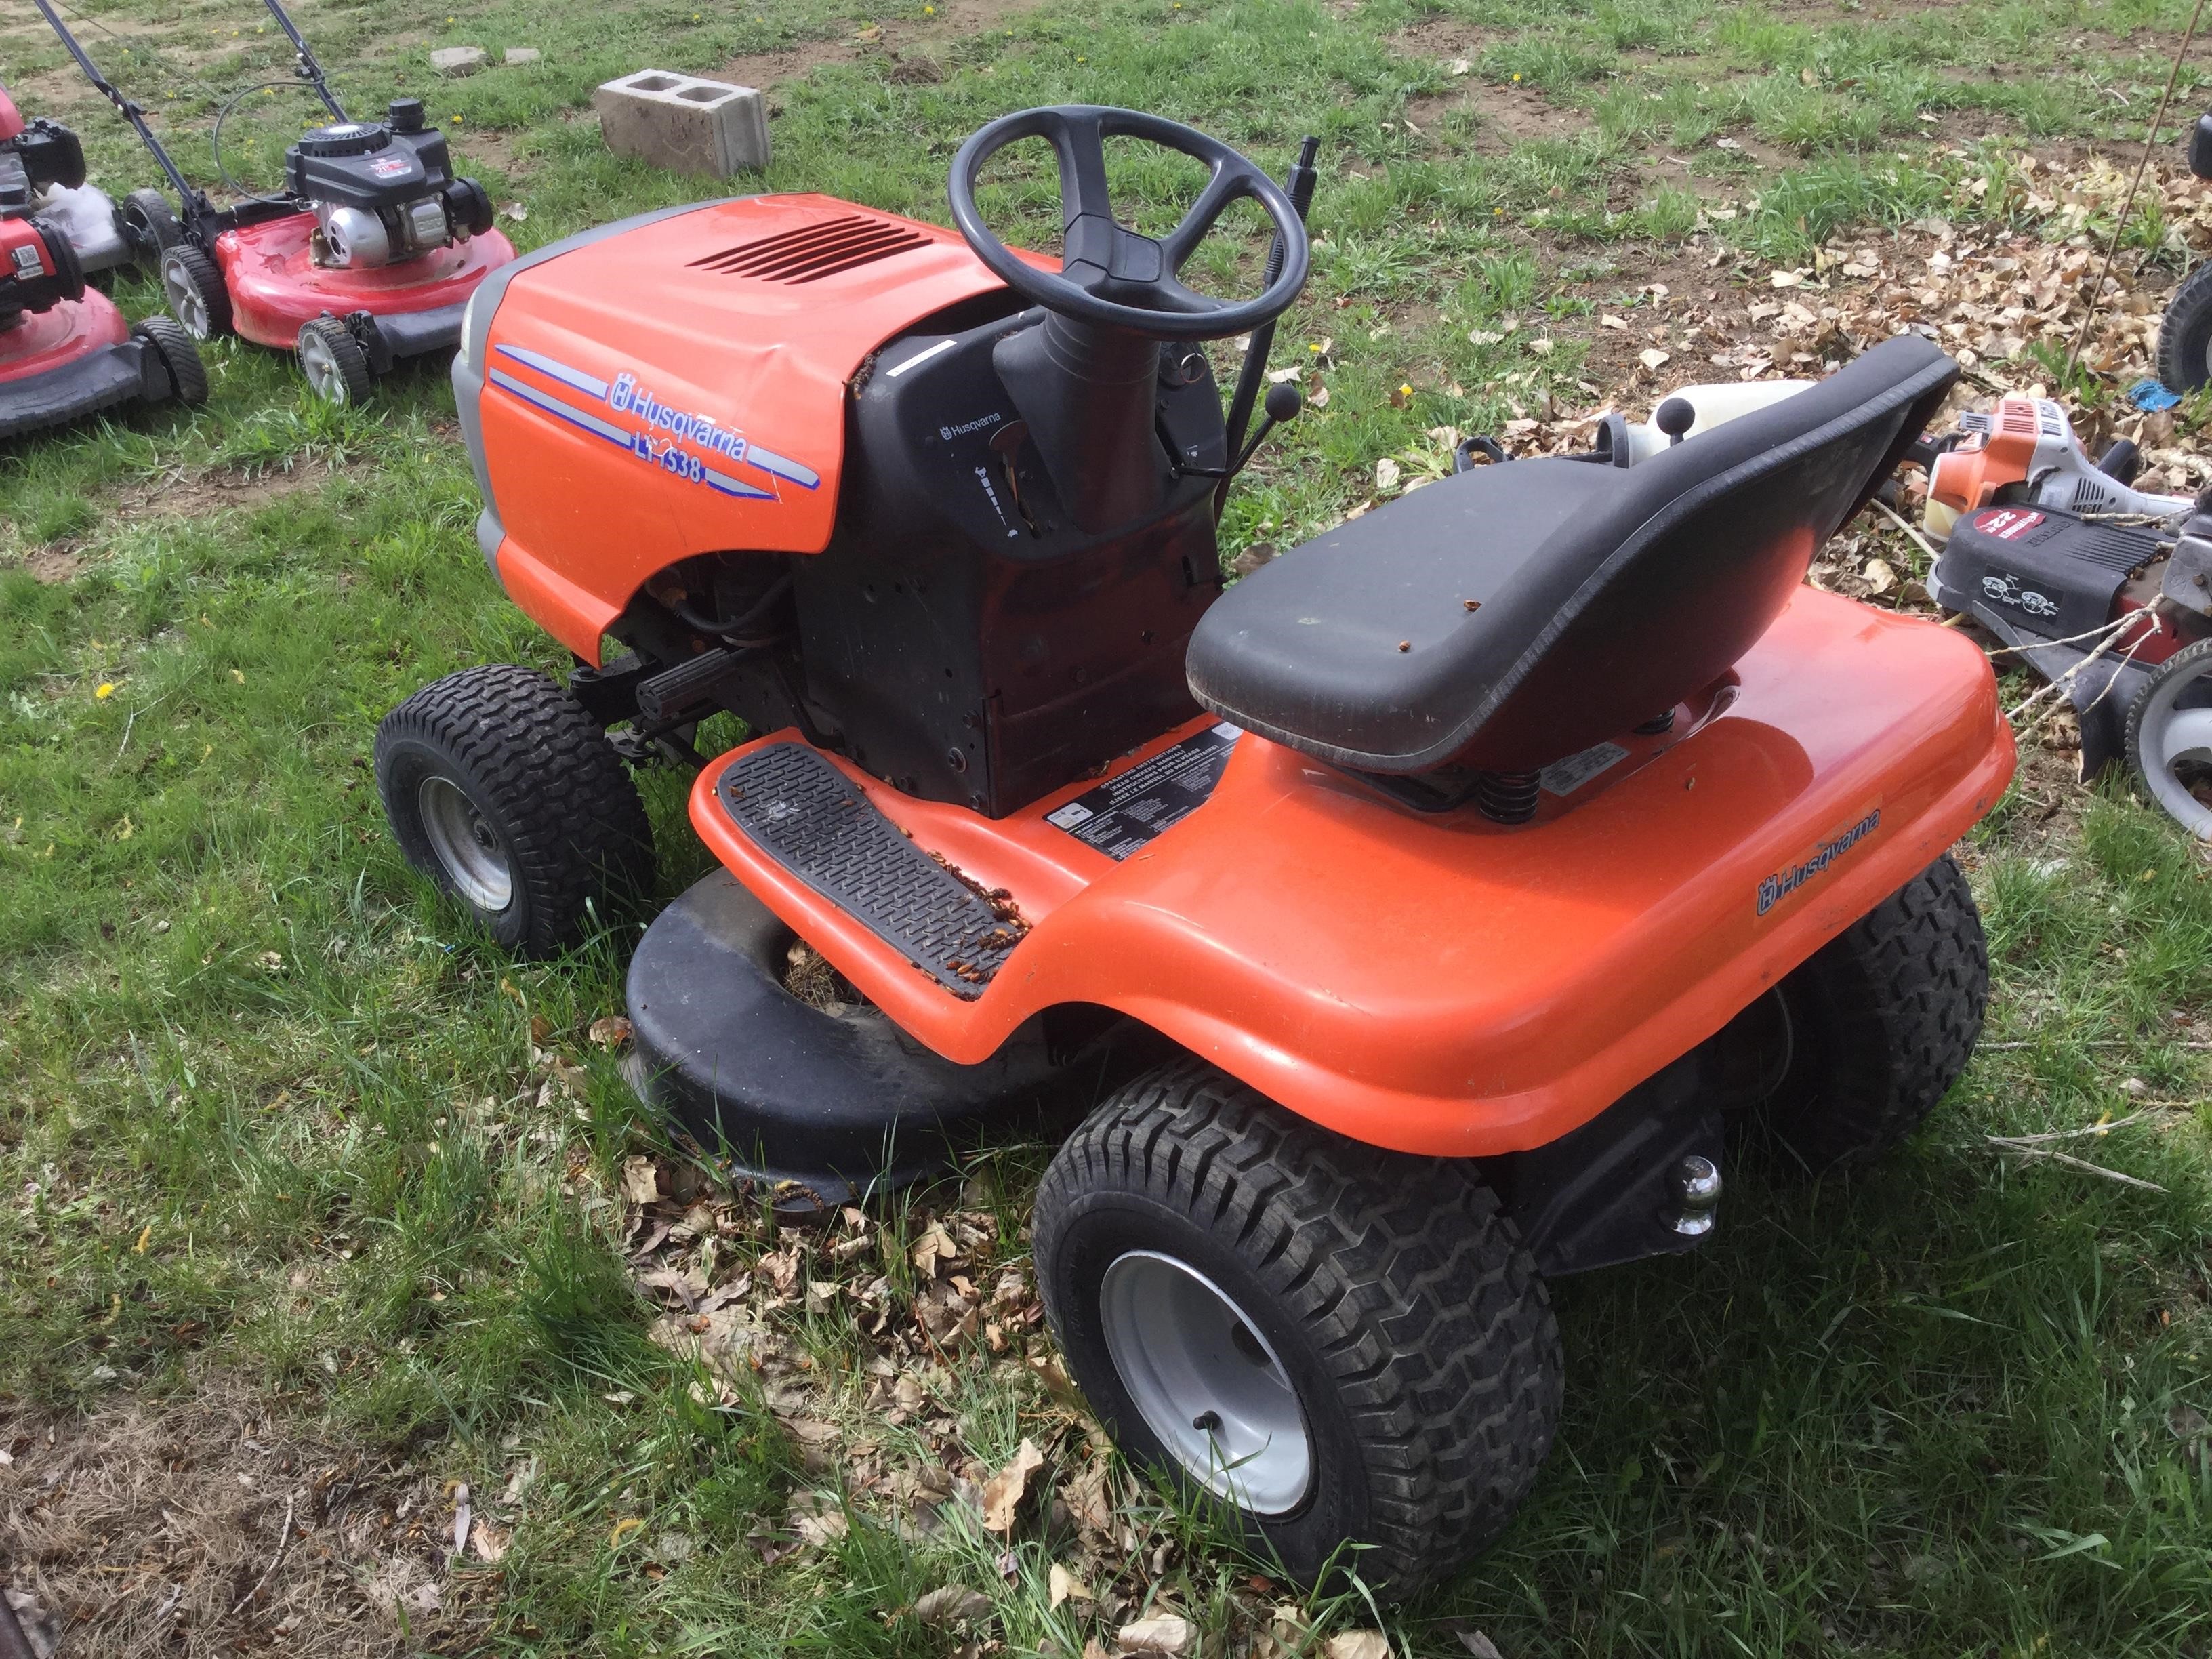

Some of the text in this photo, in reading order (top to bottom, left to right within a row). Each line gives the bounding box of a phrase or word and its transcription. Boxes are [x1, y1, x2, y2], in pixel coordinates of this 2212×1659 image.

[632, 387, 746, 462] Husqvarna
[951, 413, 1001, 436] Husqvarna
[1101, 769, 1136, 789] OPERATING
[1136, 744, 1182, 770] INSTRUCTIONS
[1112, 771, 1158, 796] INSTRUCTIONS
[1158, 761, 1175, 773] POUR
[1130, 764, 1157, 779] OWNERS
[1139, 774, 1165, 790] MANUEL
[1780, 809, 1880, 899] Husqvarna
